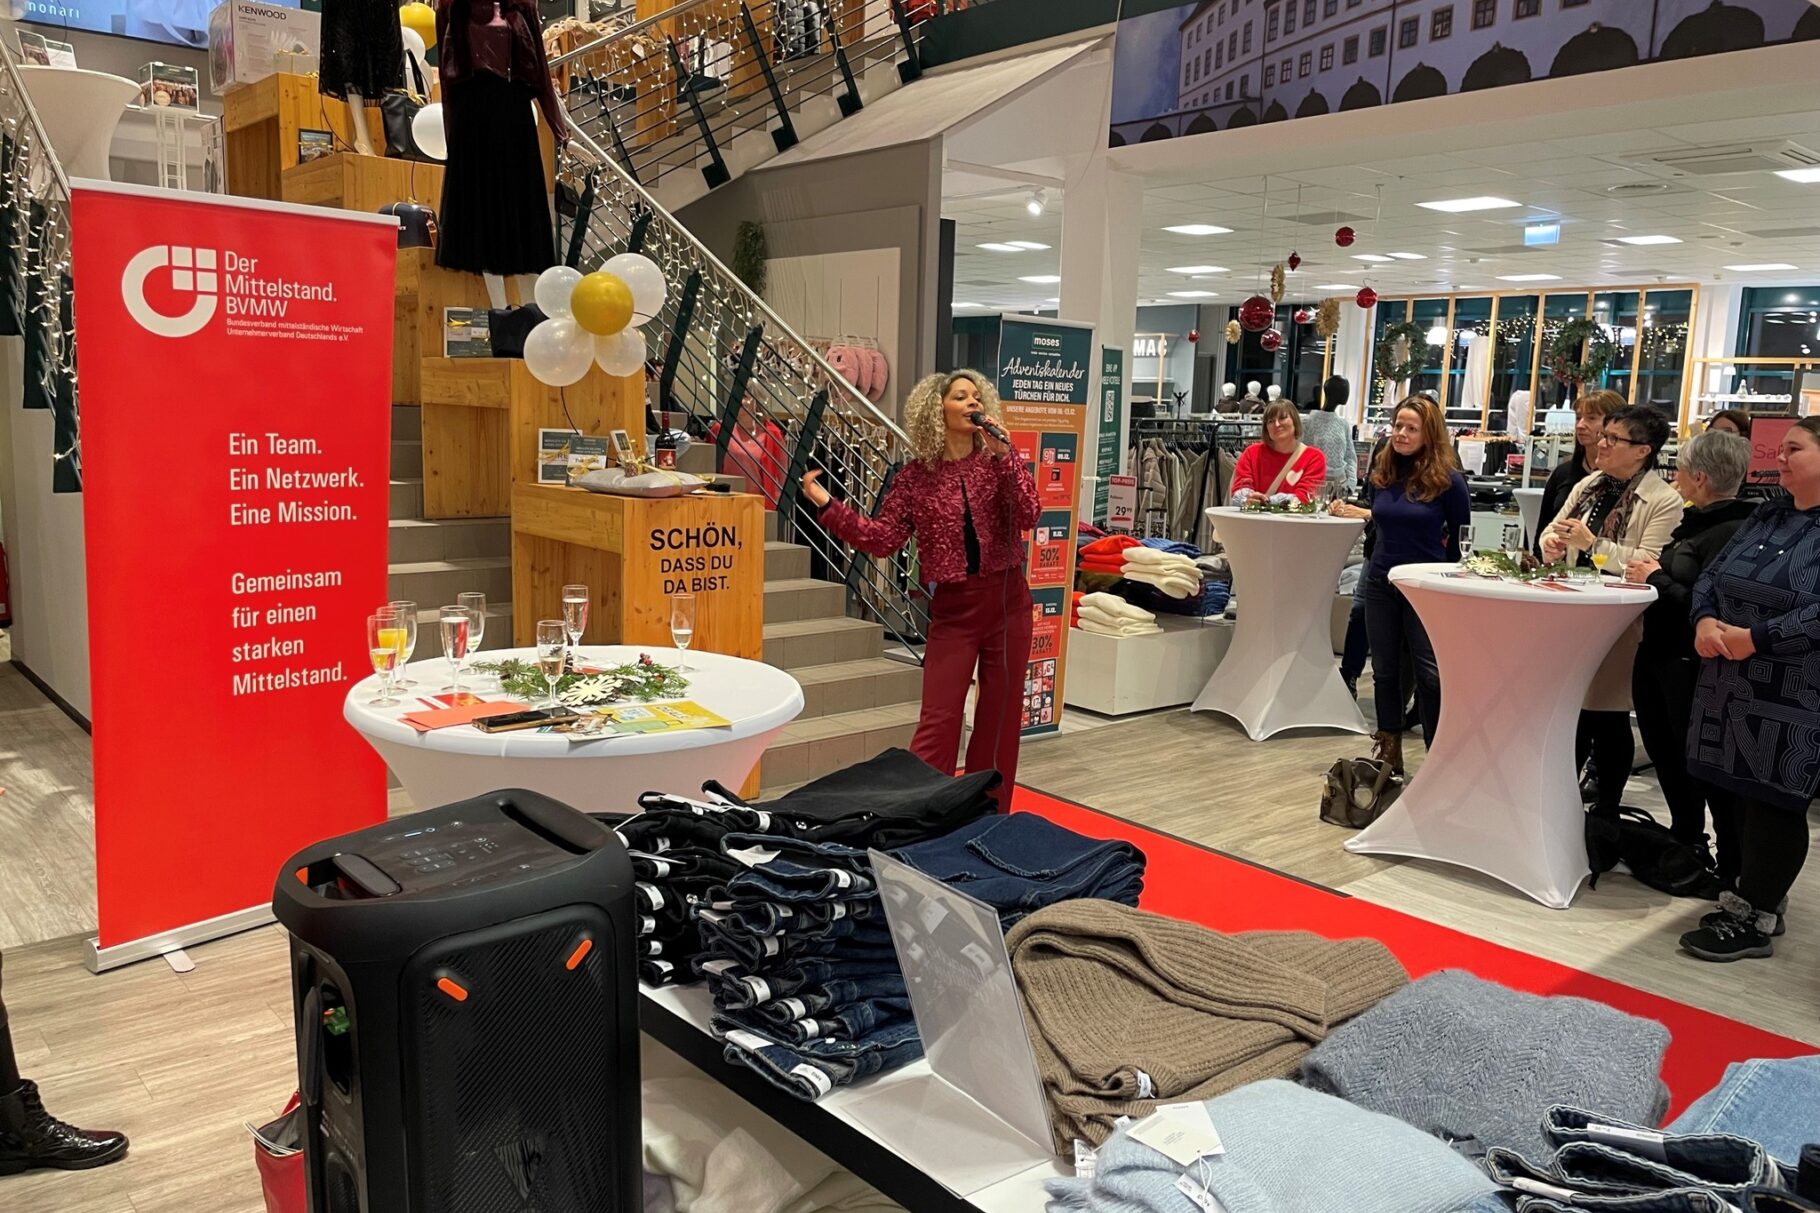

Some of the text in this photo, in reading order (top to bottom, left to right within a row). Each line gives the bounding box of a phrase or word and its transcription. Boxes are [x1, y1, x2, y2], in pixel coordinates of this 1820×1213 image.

[238, 5, 287, 20] KENWOOD
[225, 251, 258, 273] Der
[225, 273, 337, 302] Mittelstand.
[226, 296, 288, 317] BVMW
[226, 318, 364, 334] Bundesverband mittelständische Wirtschaft
[226, 327, 295, 338] Unternehmerverband
[295, 331, 338, 341] Deutschlands
[1034, 337, 1060, 347] moses
[1133, 339, 1168, 356] MAC
[1001, 357, 1085, 379] Adventskalender
[1012, 379, 1074, 392] JEDEN TAG EIN NEUES
[1014, 389, 1071, 402] TÜRCHEN FÜR DICH.
[229, 432, 322, 455] Ein Team.
[1753, 443, 1781, 460] Sal
[230, 466, 364, 490] Ein Netzwerk.
[231, 500, 357, 525] Eine Mission.
[650, 521, 743, 551] SCHÖN,
[661, 554, 733, 573] DASS DU
[1040, 547, 1060, 561] 50%
[232, 568, 342, 595] Gemeinsam
[664, 575, 730, 594] DA BIST.
[232, 602, 316, 628] für einen
[232, 636, 304, 662] starken
[1032, 634, 1053, 650] 30%
[233, 660, 348, 696] Mittelstand.
